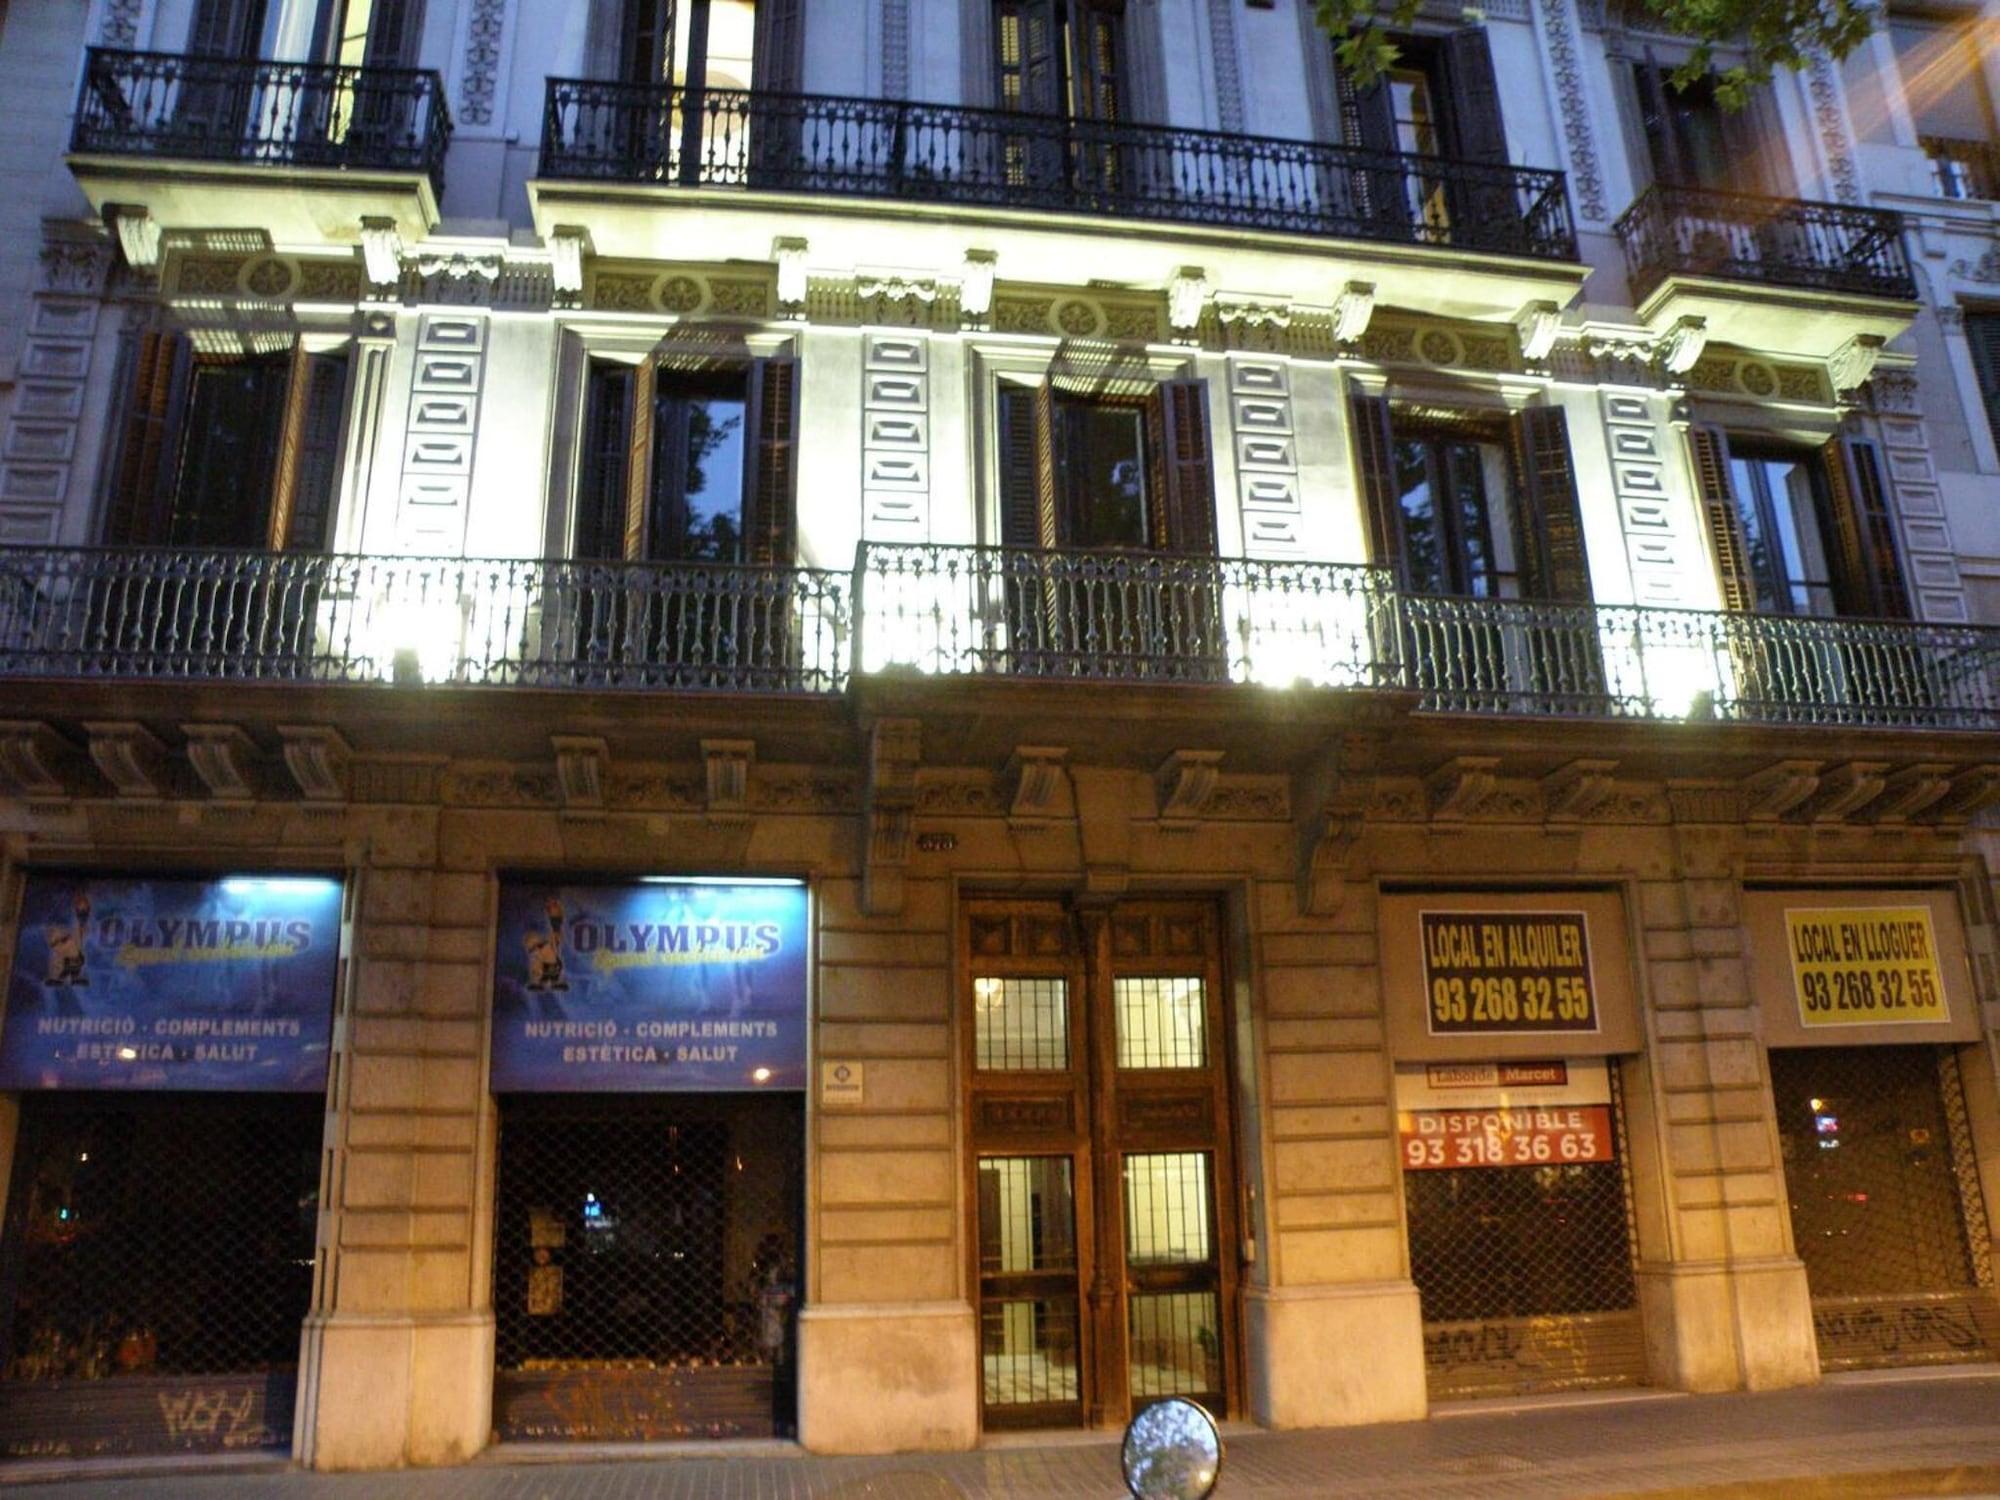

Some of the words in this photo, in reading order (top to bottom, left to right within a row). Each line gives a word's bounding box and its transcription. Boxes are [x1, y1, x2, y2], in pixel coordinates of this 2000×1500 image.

[100, 917, 312, 954] OLYMPUS
[572, 921, 781, 955] OLYMPUS
[1428, 924, 1481, 968] LOCAL
[1482, 924, 1505, 968] EN
[1509, 924, 1584, 969] ALQUILER
[1793, 924, 1841, 963] LOCAL
[1841, 923, 1863, 962] EN
[1863, 921, 1930, 961] LLOGUER
[1433, 977, 1467, 1022] 93
[1471, 976, 1519, 1021] 268
[1521, 976, 1553, 1021] 32
[1556, 976, 1589, 1020] 55
[1802, 972, 1832, 1012] 93
[1834, 970, 1876, 1010] 268
[1877, 969, 1907, 1008] 32
[1907, 968, 1937, 1007] 55
[155, 1018, 300, 1036] COMPLEMENTS
[636, 1021, 778, 1038] COMPLEMENTS
[194, 1044, 258, 1061] SALUT
[677, 1045, 738, 1063] SALUT
[1506, 1067, 1557, 1081] Marcet
[1419, 1110, 1584, 1134] DISPONIBLE
[1407, 1139, 1445, 1165] 93
[1456, 1137, 1504, 1163] 318
[1514, 1135, 1551, 1161] 36
[1560, 1133, 1597, 1159] 63
